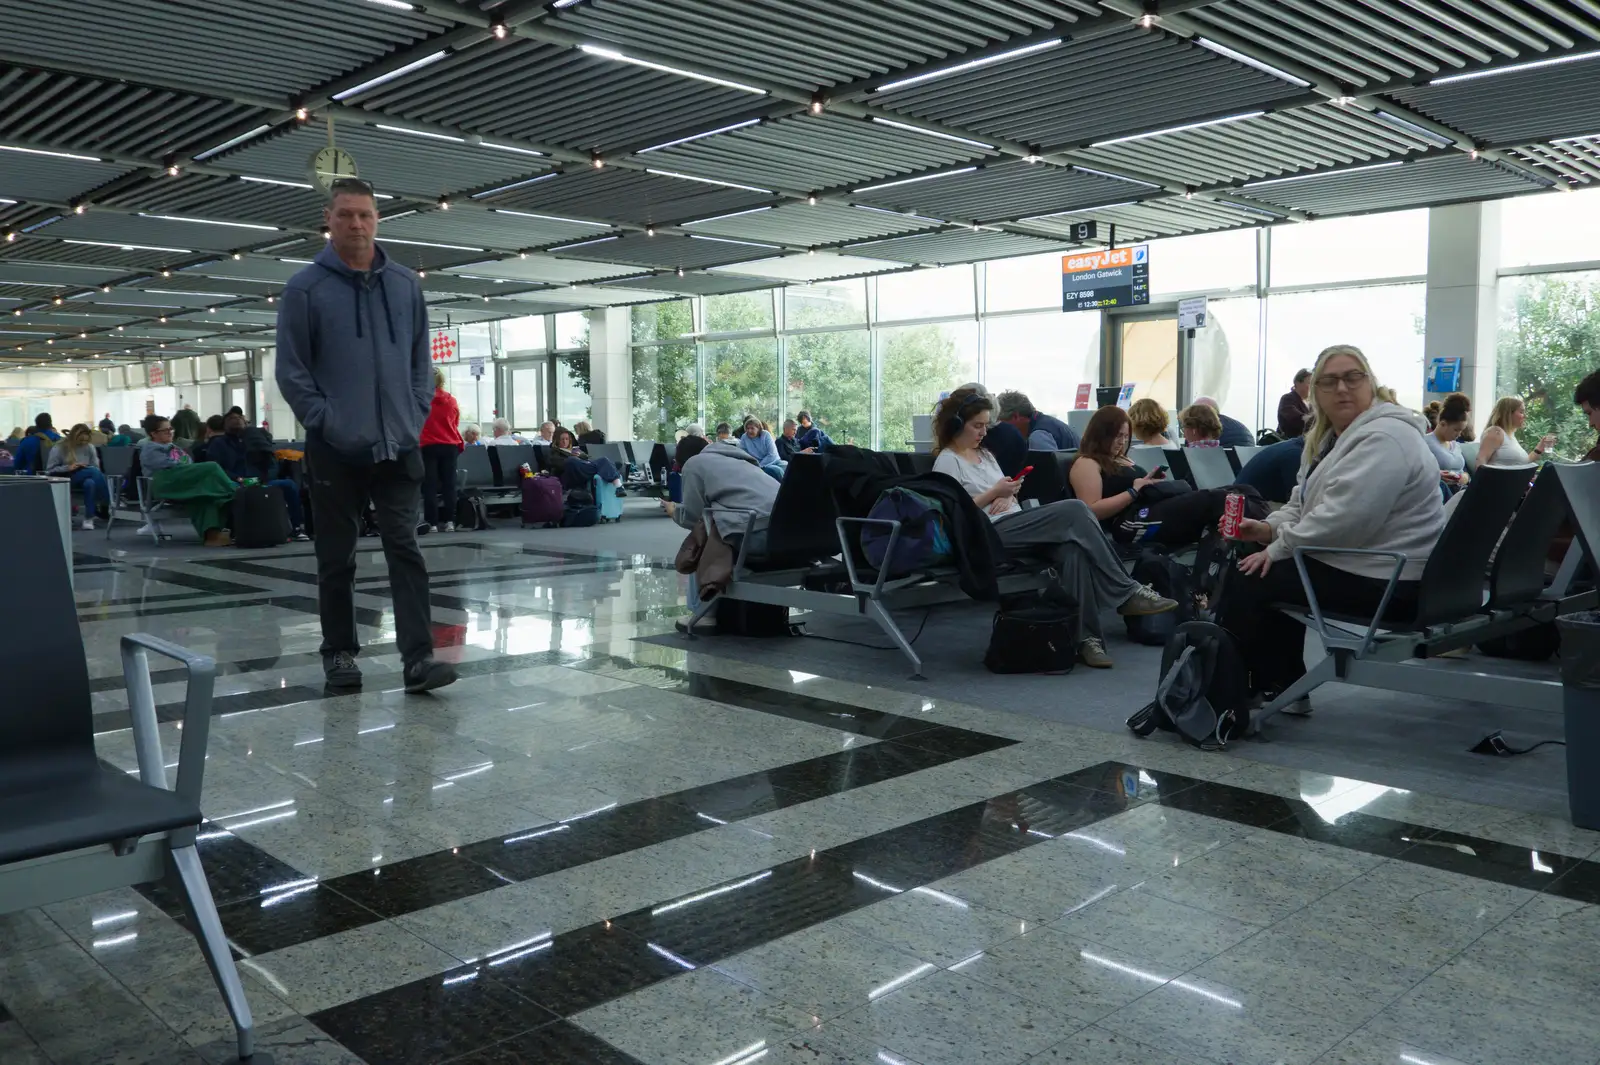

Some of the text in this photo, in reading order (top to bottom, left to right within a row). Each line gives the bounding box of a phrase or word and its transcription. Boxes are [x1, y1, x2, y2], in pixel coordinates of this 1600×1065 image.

[1078, 223, 1088, 239] 9
[1067, 249, 1128, 270] easyJet
[1072, 271, 1096, 282] London
[1096, 269, 1123, 279] Gatwick
[1066, 290, 1095, 300] EZY 8598
[1084, 298, 1117, 308] 12:30 12:40
